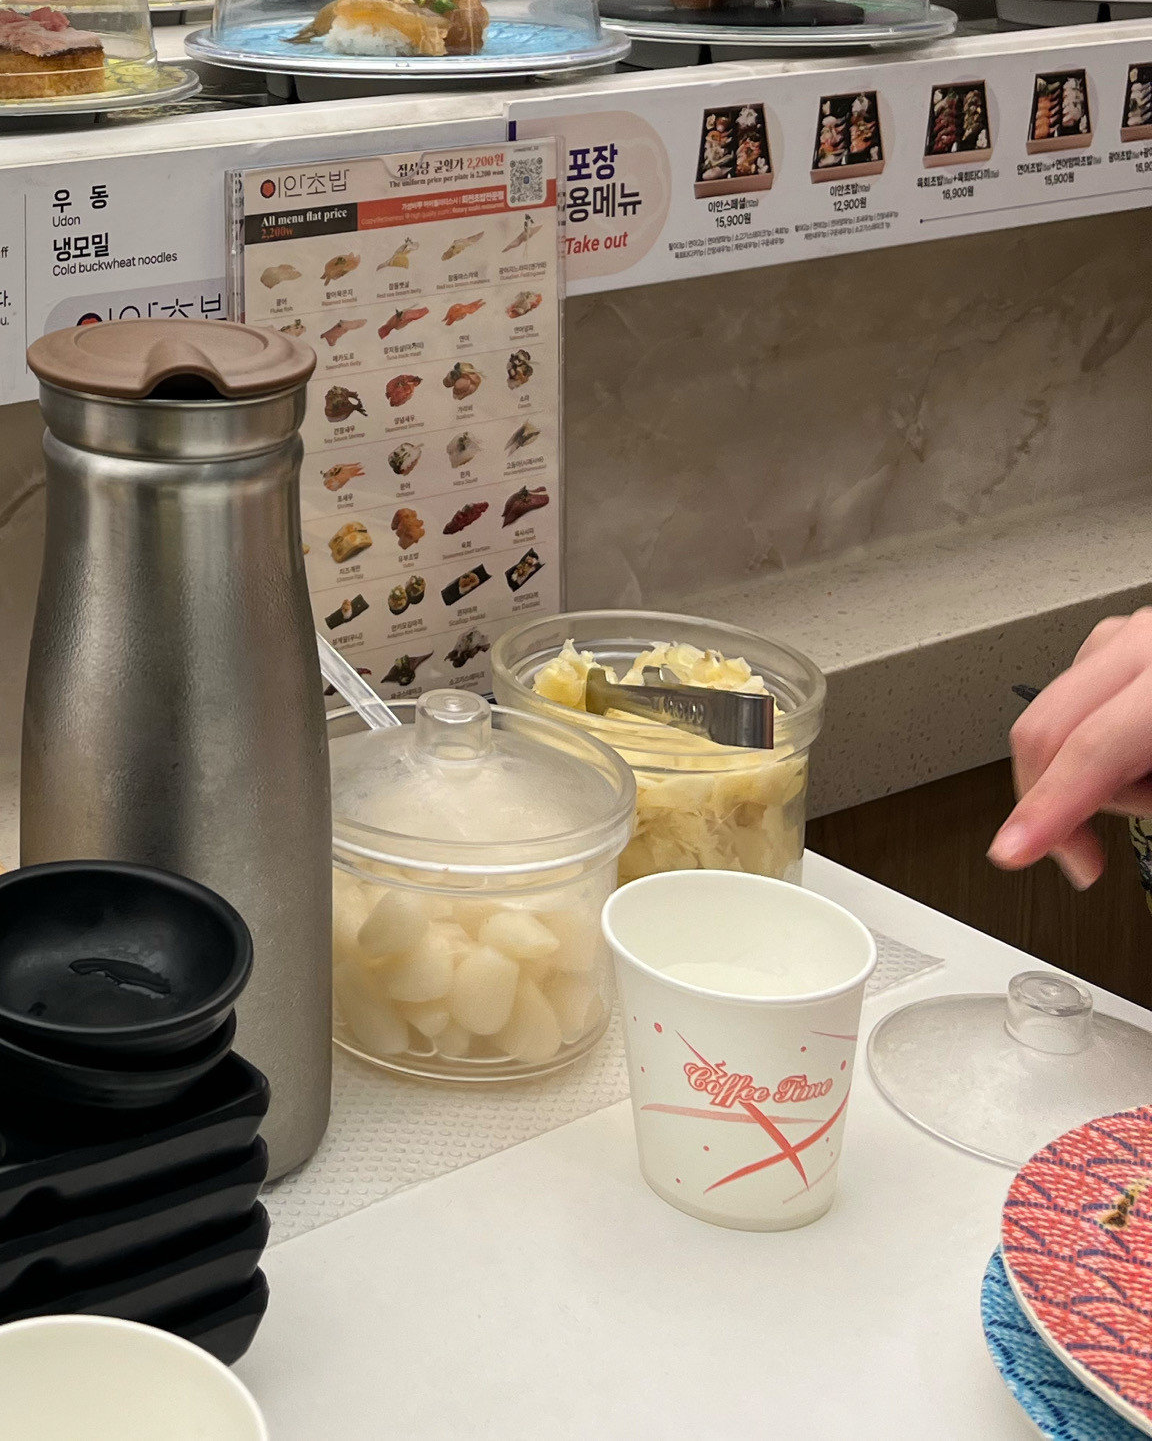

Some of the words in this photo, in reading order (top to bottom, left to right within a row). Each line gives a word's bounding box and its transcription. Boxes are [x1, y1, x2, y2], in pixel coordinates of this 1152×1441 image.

[566, 143, 618, 182] 포장
[52, 189, 72, 213] 우
[89, 184, 109, 209] 동
[833, 196, 867, 212] 12,900원
[52, 214, 81, 228] Udon
[260, 216, 276, 228] All
[278, 213, 304, 226] menu
[306, 210, 323, 223] flat
[323, 208, 348, 223] price
[715, 212, 752, 228] 15,900원
[53, 232, 110, 262] 냉모밀
[565, 236, 600, 255] Take
[604, 231, 629, 249] out
[52, 262, 77, 277] Cold
[78, 256, 136, 274] buckwheat
[137, 251, 178, 266] noodles
[683, 1061, 771, 1108] Coffee
[772, 1074, 833, 1103] Time
